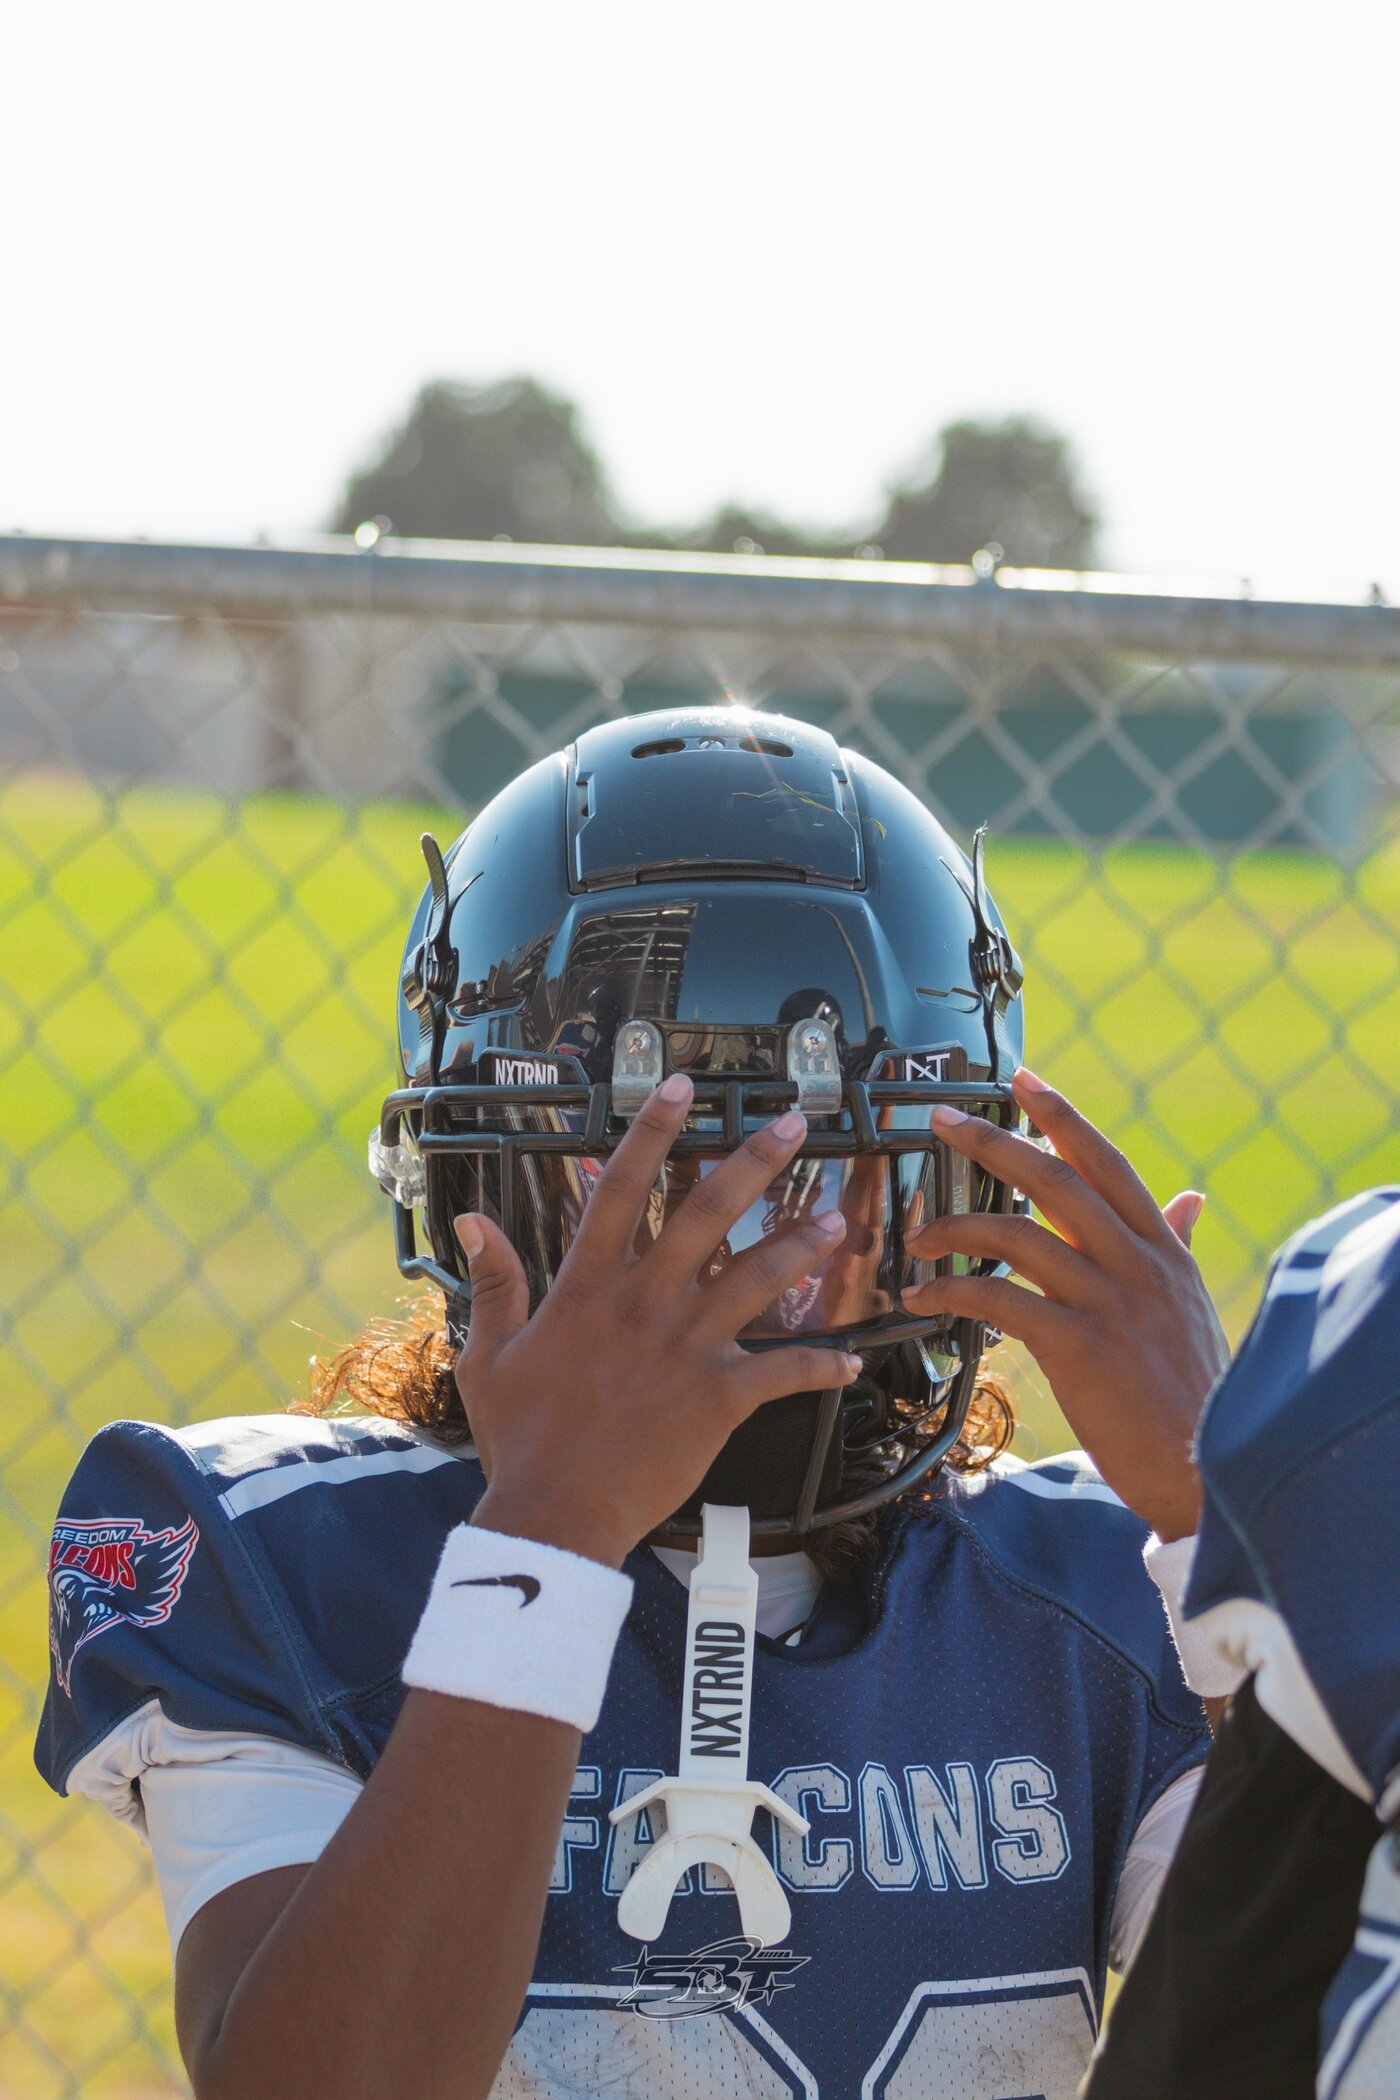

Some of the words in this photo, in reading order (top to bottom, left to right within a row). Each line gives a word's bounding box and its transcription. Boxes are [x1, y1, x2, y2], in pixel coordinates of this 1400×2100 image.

[495, 1059, 558, 1085] NXTRND
[52, 1529, 126, 1544] REEDOM
[50, 1540, 136, 1590] LCONS
[690, 1621, 746, 1758] NXTRND
[545, 1755, 1071, 1895] FACONS
